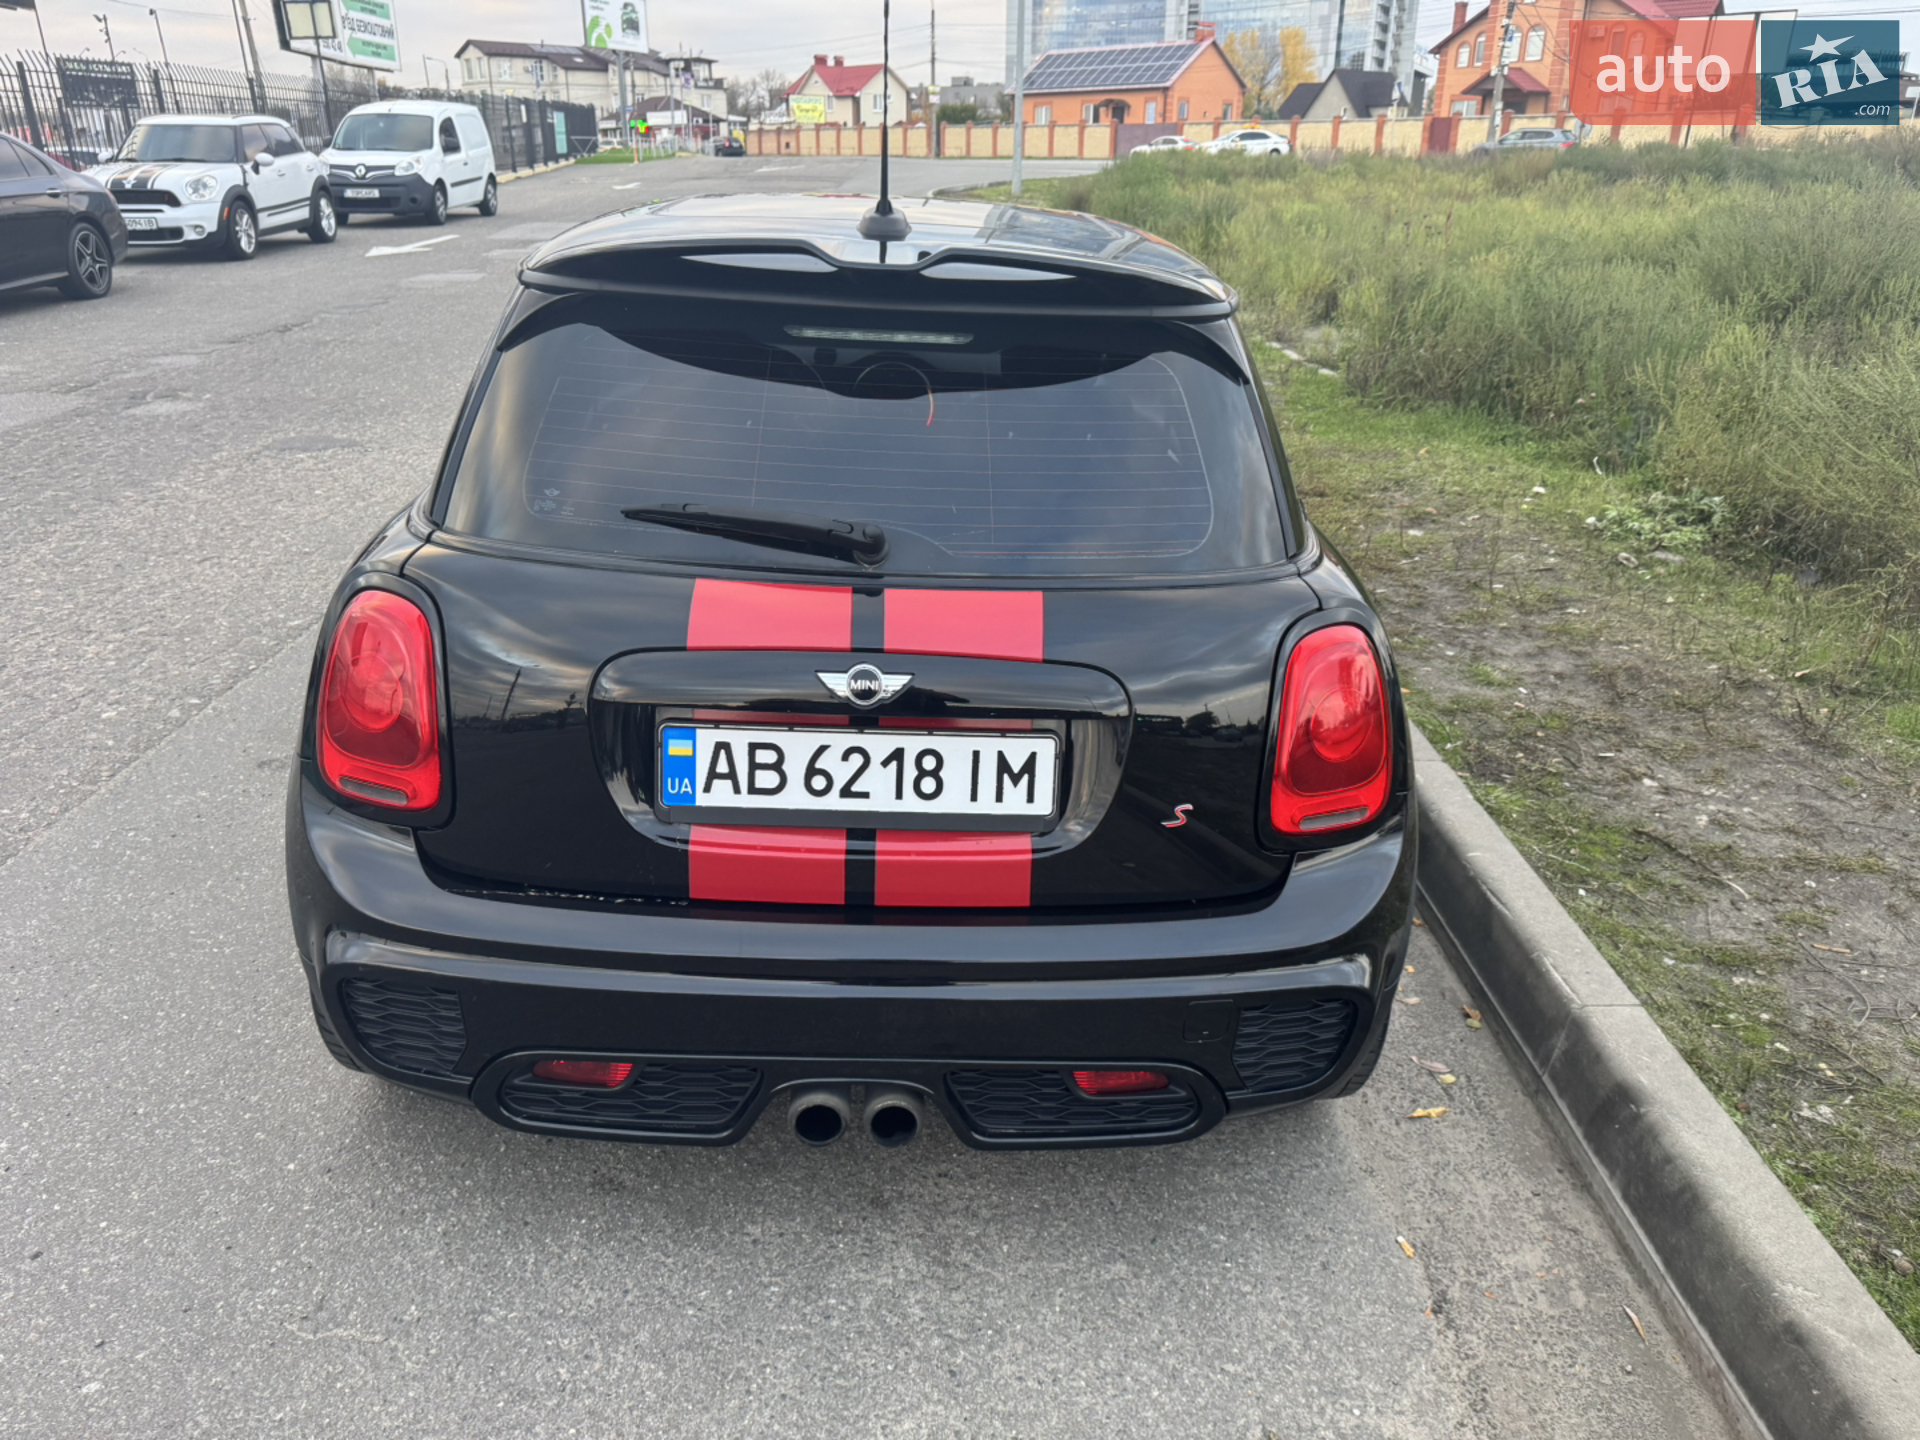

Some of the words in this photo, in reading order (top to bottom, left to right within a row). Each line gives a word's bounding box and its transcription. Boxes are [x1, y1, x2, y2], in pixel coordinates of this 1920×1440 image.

[850, 679, 880, 691] MINI
[702, 740, 788, 796] AB
[803, 744, 944, 801] 6218
[970, 750, 1038, 804] IM
[667, 777, 693, 795] UA
[1160, 803, 1194, 828] S
